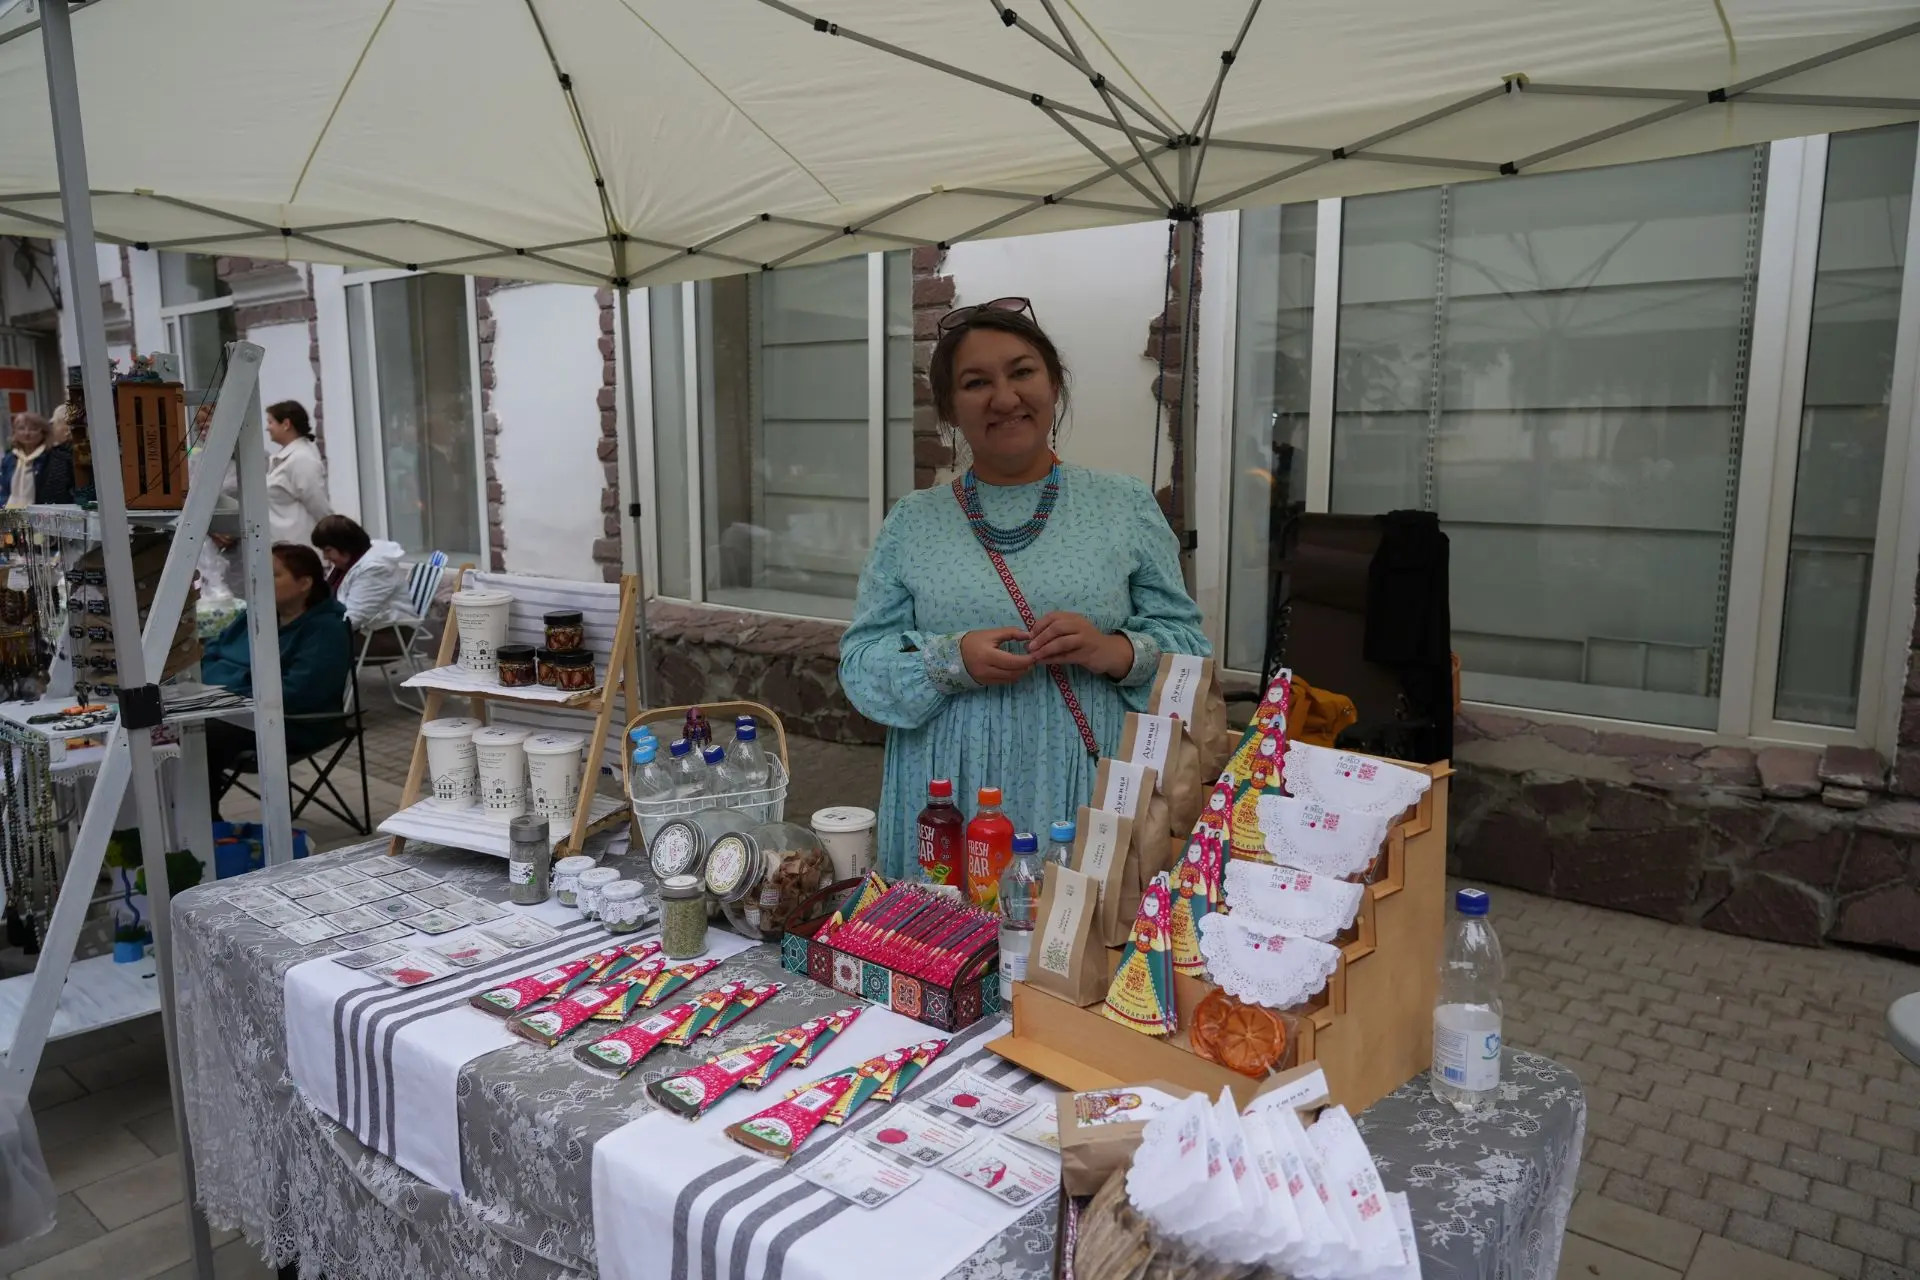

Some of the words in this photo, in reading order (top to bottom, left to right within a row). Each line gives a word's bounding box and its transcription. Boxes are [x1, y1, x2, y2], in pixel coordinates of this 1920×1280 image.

[1142, 722, 1155, 759] Душица
[1114, 776, 1126, 815] Душица
[967, 840, 989, 857] FRESH
[968, 855, 989, 877] BAR
